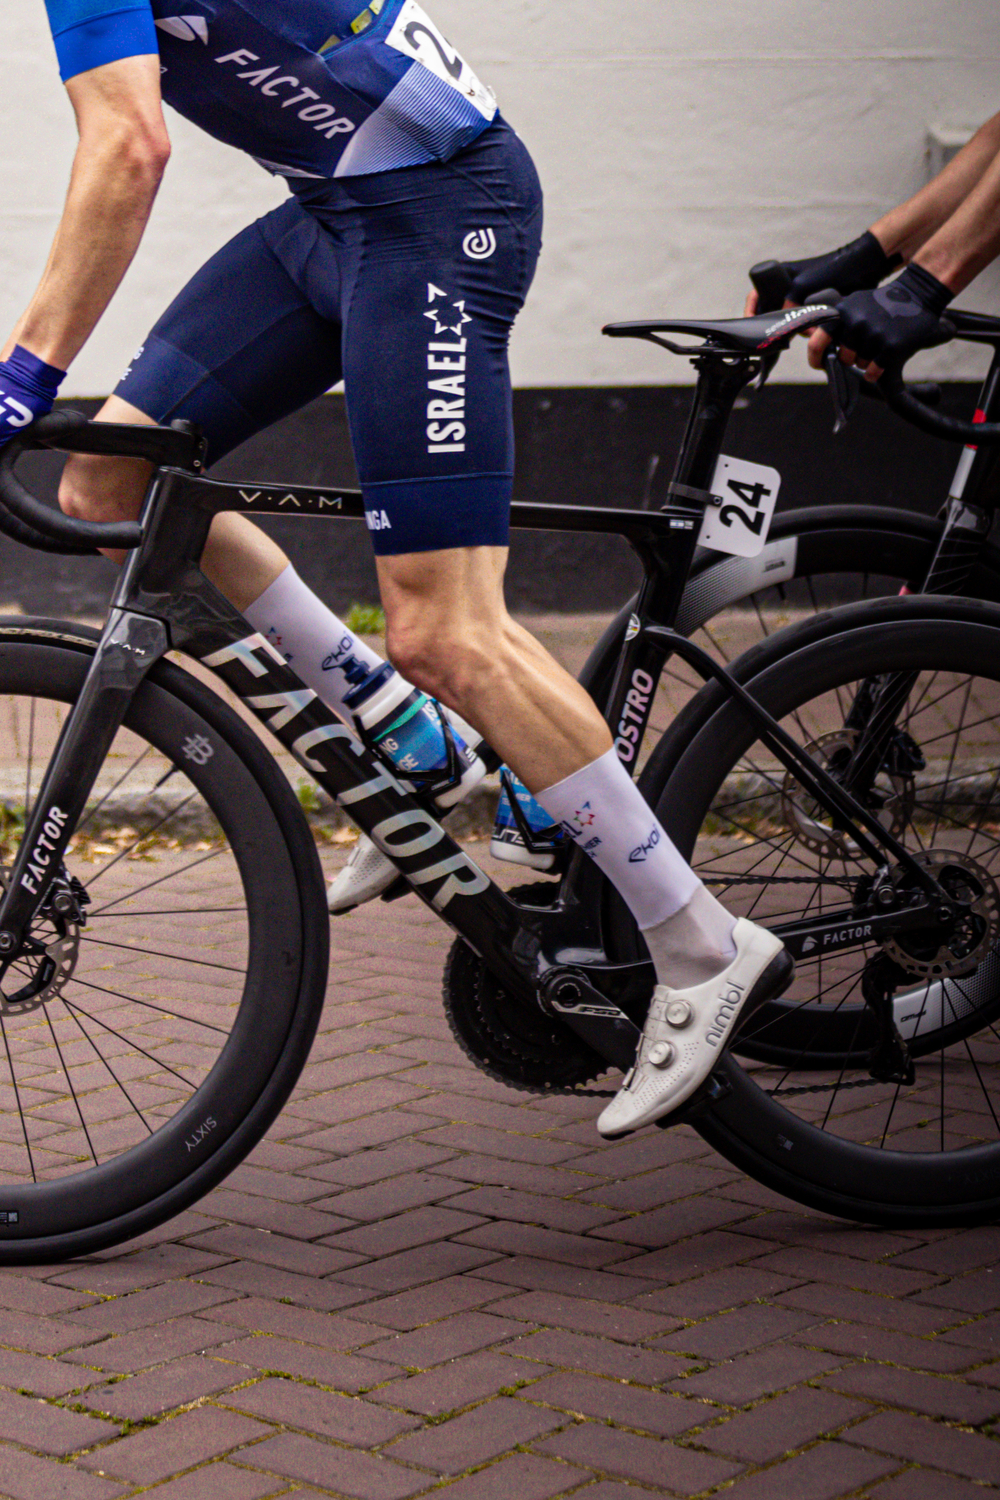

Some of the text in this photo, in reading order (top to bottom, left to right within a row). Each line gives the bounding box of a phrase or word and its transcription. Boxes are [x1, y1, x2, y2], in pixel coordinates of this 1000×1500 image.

[214, 48, 356, 140] FACTOR
[426, 337, 467, 454] ISRAEL
[718, 478, 771, 536] 24
[614, 667, 654, 763] OSTRO
[200, 632, 491, 912] FACTOR
[20, 806, 69, 895] FACTOR
[823, 924, 872, 946] FACTOR
[705, 980, 745, 1048] nimbl
[184, 1116, 218, 1152] SIXTY
